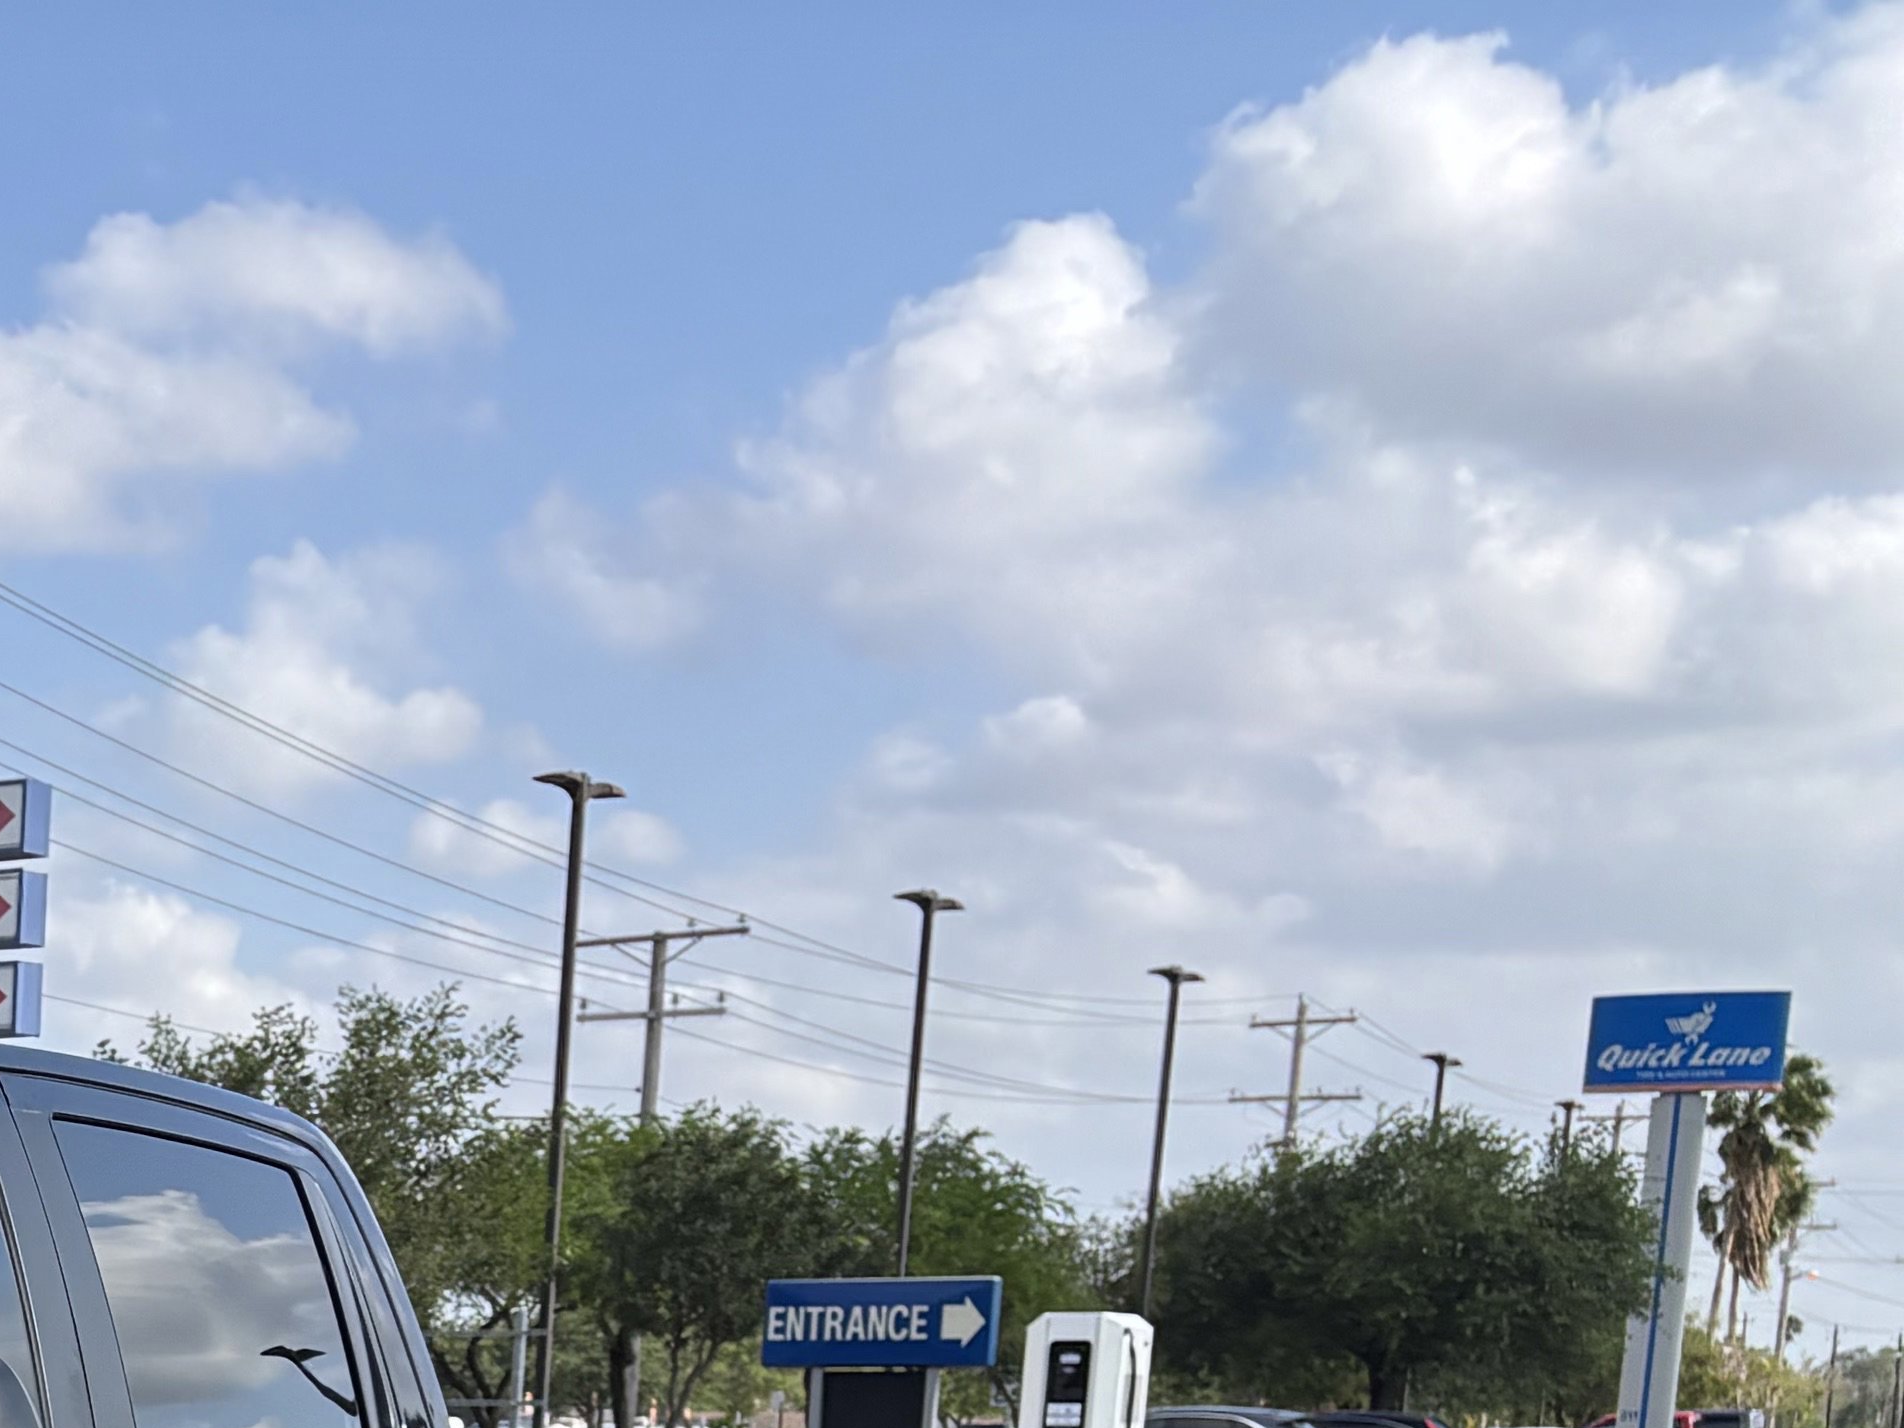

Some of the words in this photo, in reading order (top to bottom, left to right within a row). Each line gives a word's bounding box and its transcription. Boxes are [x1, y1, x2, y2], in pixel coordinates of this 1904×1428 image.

[1597, 1041, 1688, 1072] Quick
[1688, 1041, 1773, 1067] Lane
[766, 1303, 930, 1343] ENTRANCE
